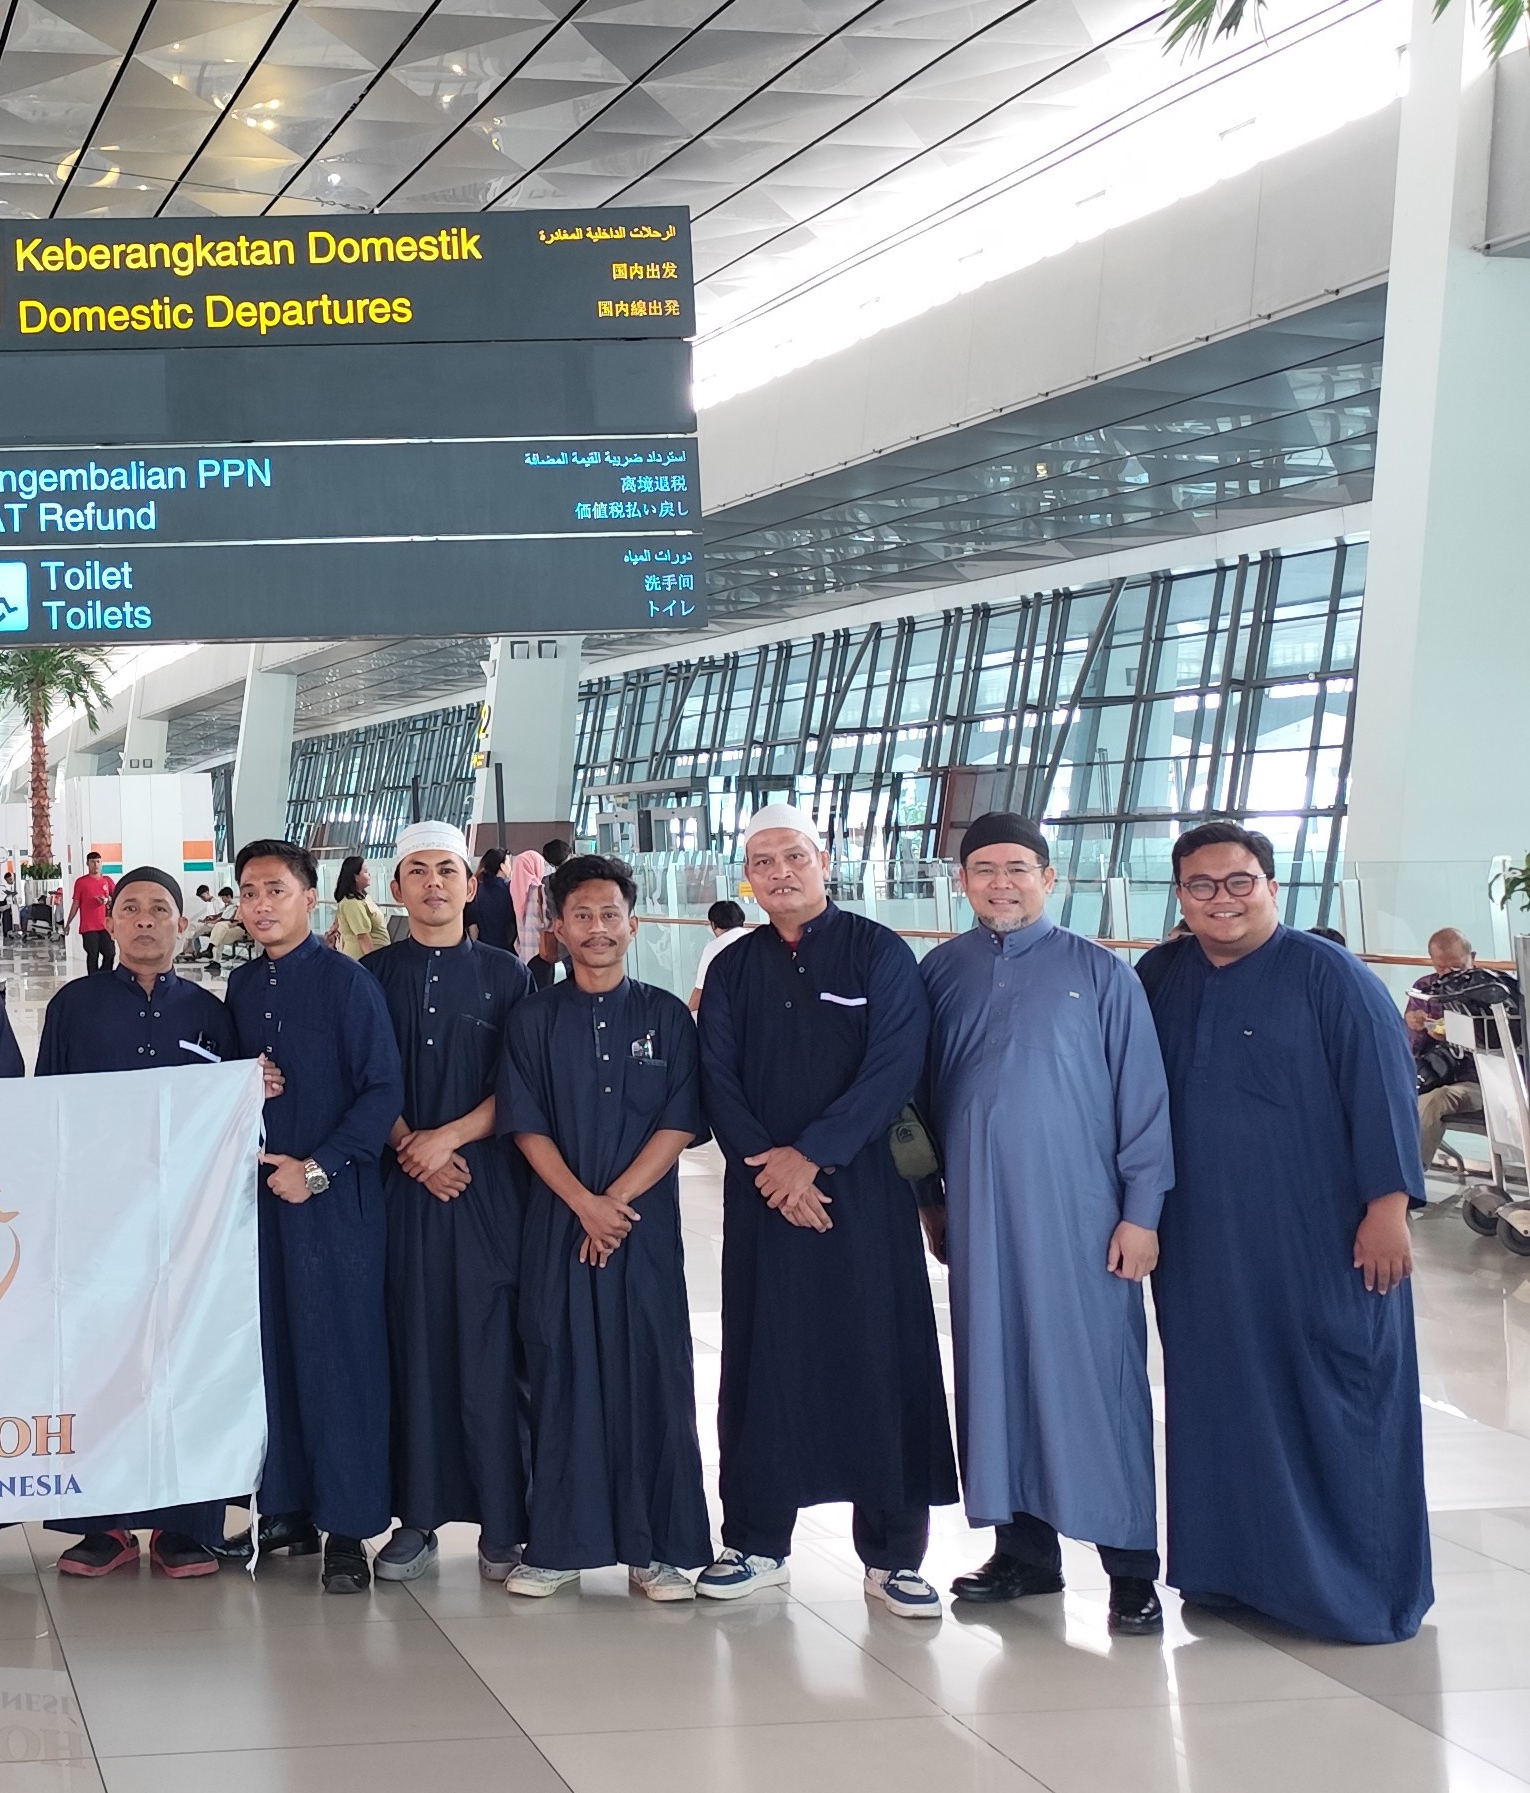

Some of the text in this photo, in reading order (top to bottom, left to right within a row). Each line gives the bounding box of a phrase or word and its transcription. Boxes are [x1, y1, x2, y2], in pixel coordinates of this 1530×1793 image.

[15, 227, 483, 277] Keberangkatan Domestik
[612, 262, 678, 280] 国内出发
[19, 293, 413, 335] Domestic Departures
[598, 300, 680, 317] 国内線出発
[198, 457, 271, 489] PPN
[621, 475, 687, 493] 离境退税
[39, 500, 156, 532] Refund
[575, 501, 689, 520] 価値税払い戻し
[654, 549, 692, 565] دورات
[40, 560, 133, 591] Toilet
[644, 574, 694, 592] 洗手间
[41, 599, 152, 630] Toilets
[648, 600, 696, 618] トイレ
